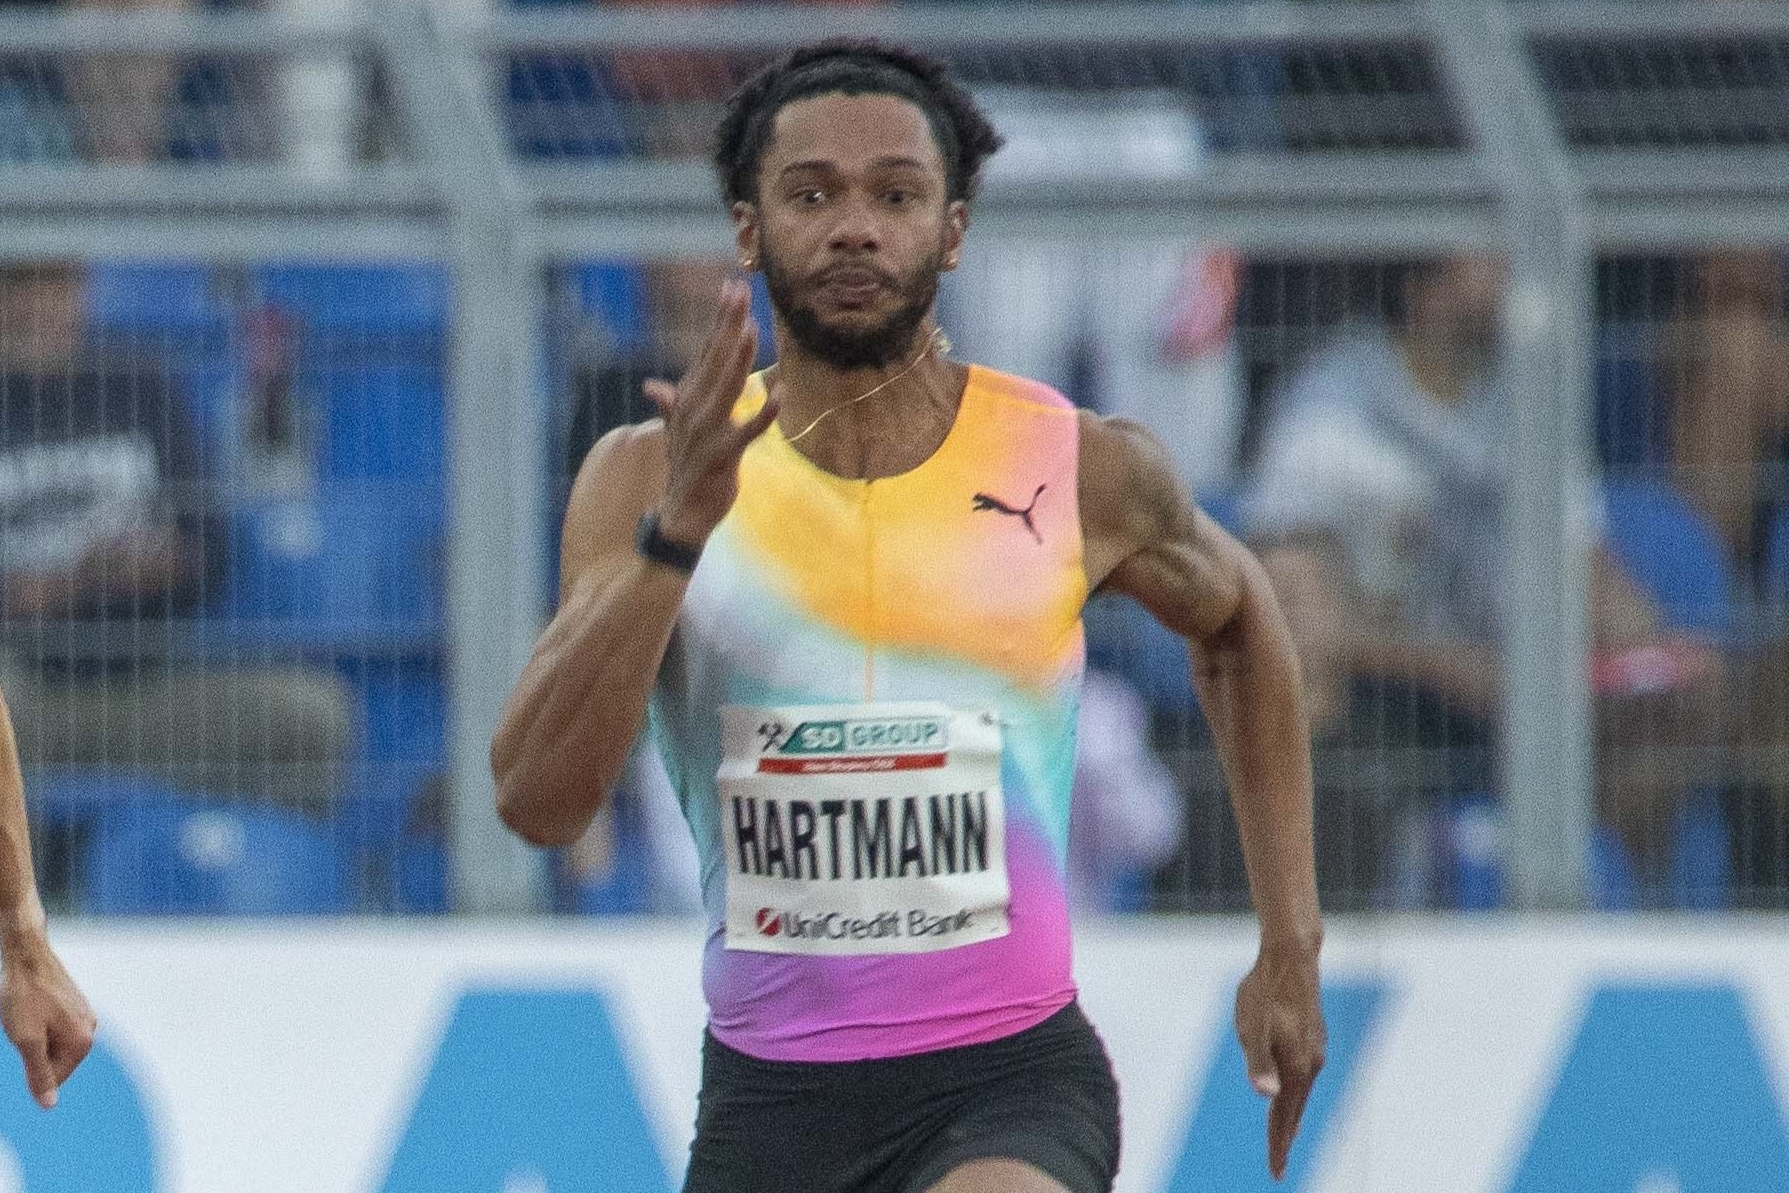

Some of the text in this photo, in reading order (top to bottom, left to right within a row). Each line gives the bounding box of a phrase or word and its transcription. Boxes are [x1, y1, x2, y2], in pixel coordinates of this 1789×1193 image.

[852, 722, 939, 746] GROUP
[731, 790, 991, 881] HARTMANN
[781, 905, 974, 940] UniCredit Bank
